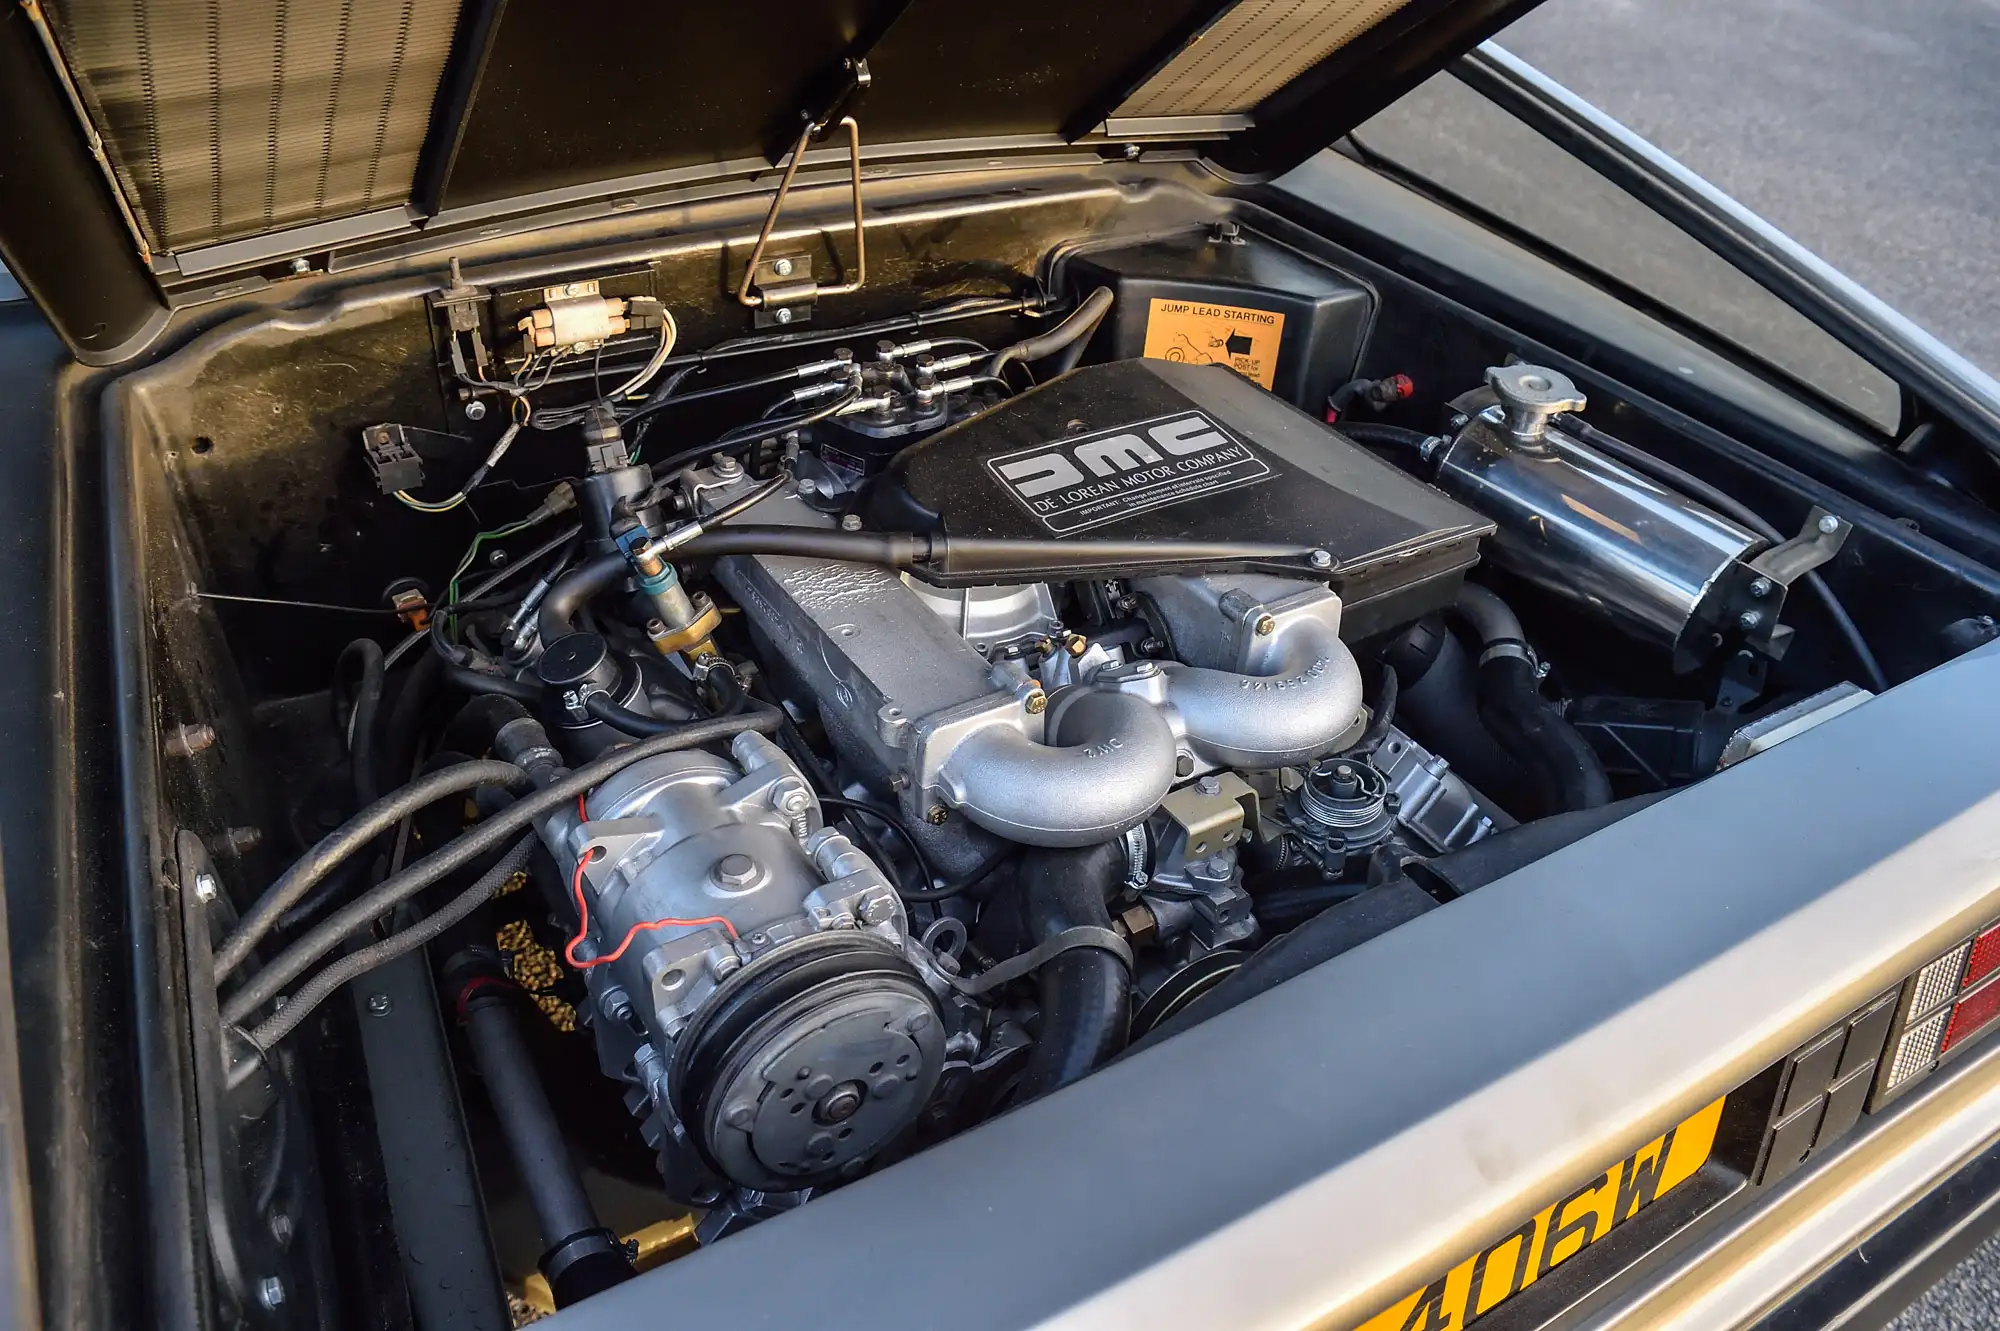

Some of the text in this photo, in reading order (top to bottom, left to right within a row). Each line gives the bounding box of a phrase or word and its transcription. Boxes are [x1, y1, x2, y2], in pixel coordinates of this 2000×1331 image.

[1160, 303, 1275, 325] JUMP LEAD STARTING
[998, 415, 1229, 498] DMC
[1033, 446, 1243, 513] DE LOREAN MOTOR COMPANY
[1080, 499, 1122, 516] IMPORTANT:
[1122, 493, 1147, 503] Change
[1147, 485, 1171, 496] element
[1178, 477, 1204, 488] intervals
[1204, 470, 1231, 482] specified
[1136, 491, 1175, 506] maintenance
[1175, 484, 1202, 496] schedule
[1202, 479, 1219, 489] chart
[1399, 1127, 1678, 1331] 406W
